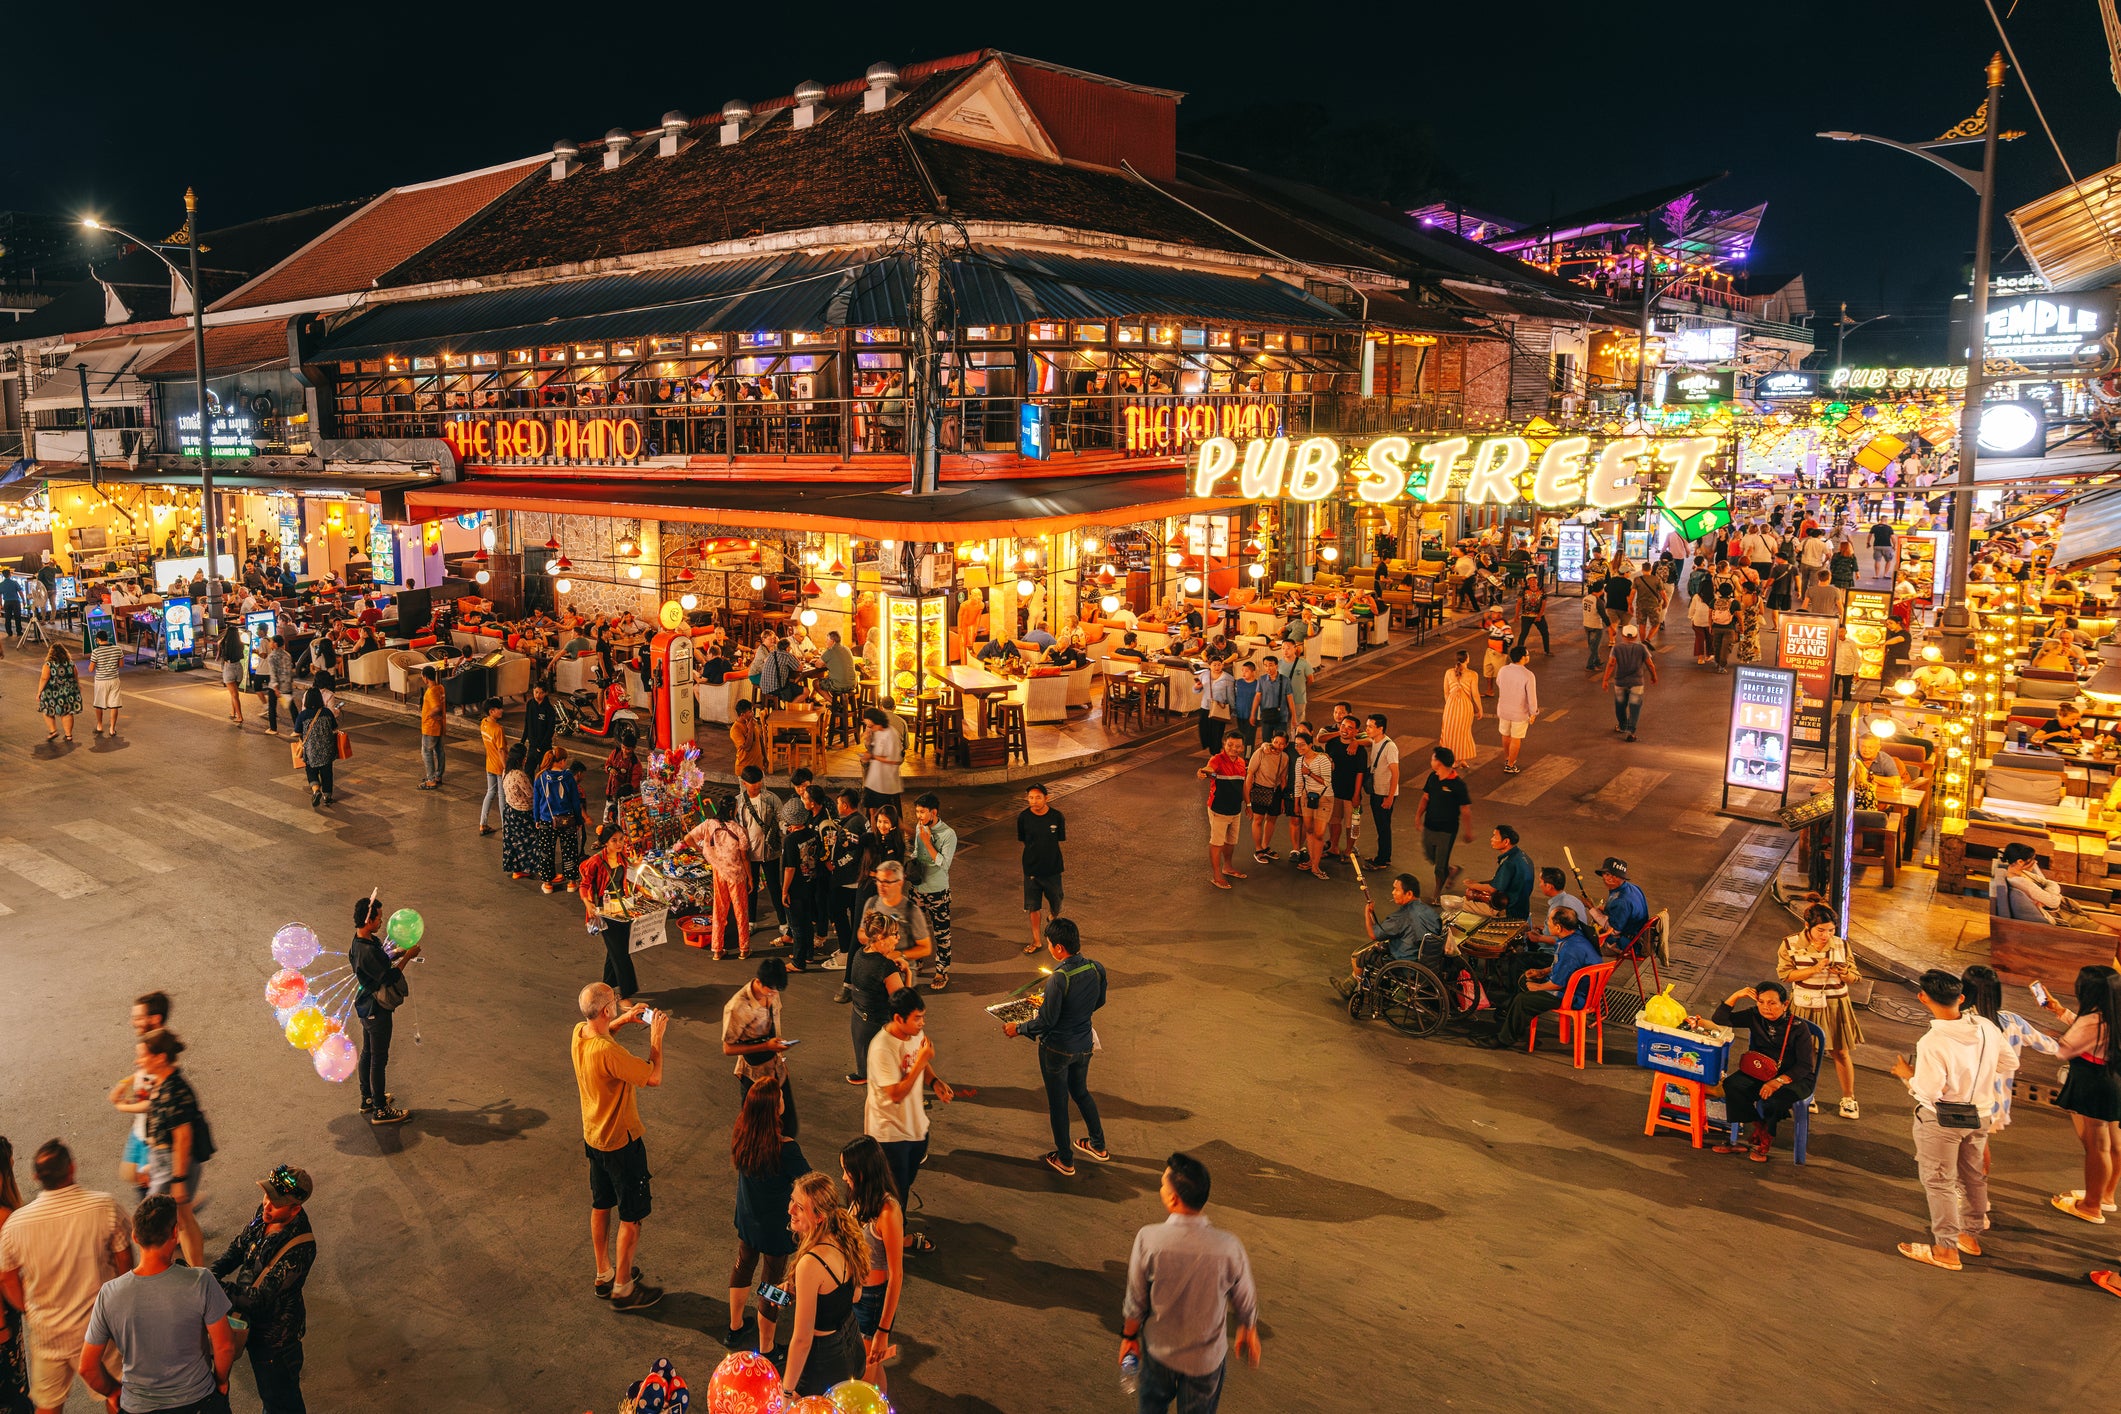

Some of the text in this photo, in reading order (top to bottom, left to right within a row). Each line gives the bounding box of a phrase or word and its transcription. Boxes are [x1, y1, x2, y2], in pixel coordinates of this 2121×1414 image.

[1831, 366, 1968, 388] PUB STRE
[1124, 403, 1279, 450] THE RED PIANO
[445, 419, 492, 457] THE
[495, 419, 548, 458] RED
[554, 418, 642, 460] PIANO
[1195, 436, 1719, 507] PUB STREET
[1787, 624, 1829, 640] LIVE
[1787, 637, 1827, 647] WESTERN
[1786, 643, 1827, 657] BAND
[1785, 656, 1825, 667] UPSTAIRS
[1743, 683, 1784, 695] DRAFT BEER
[1742, 692, 1783, 705] COCKTAILS
[1799, 720, 1821, 728] MIXER
[1612, 861, 1627, 873] Pedro
